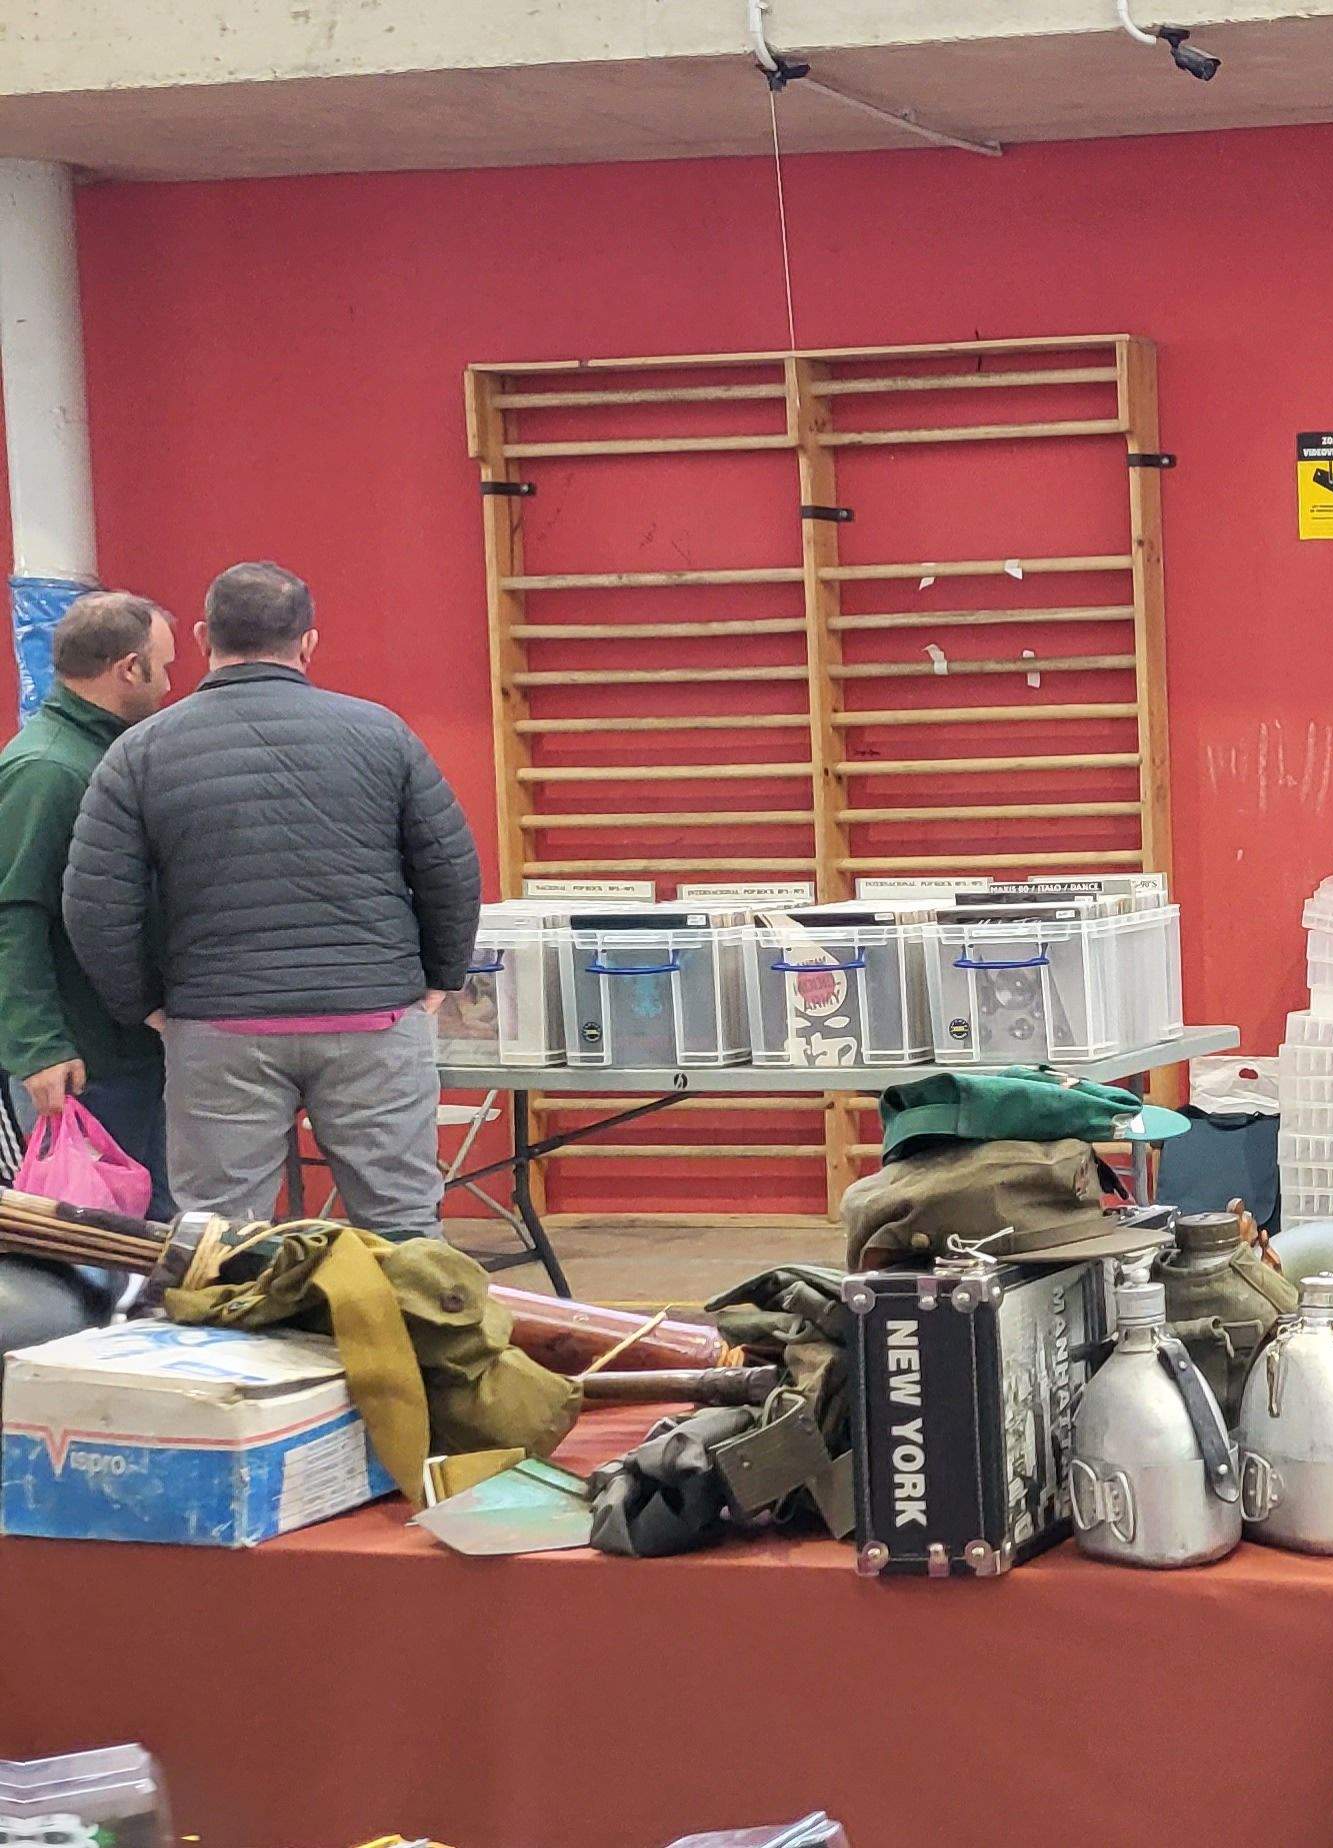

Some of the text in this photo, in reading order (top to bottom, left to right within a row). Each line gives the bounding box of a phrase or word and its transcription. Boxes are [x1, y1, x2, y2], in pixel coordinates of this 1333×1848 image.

[1038, 884, 1062, 893] ITALO
[1070, 883, 1100, 892] DANCE
[885, 1319, 928, 1529] NEW YORK
